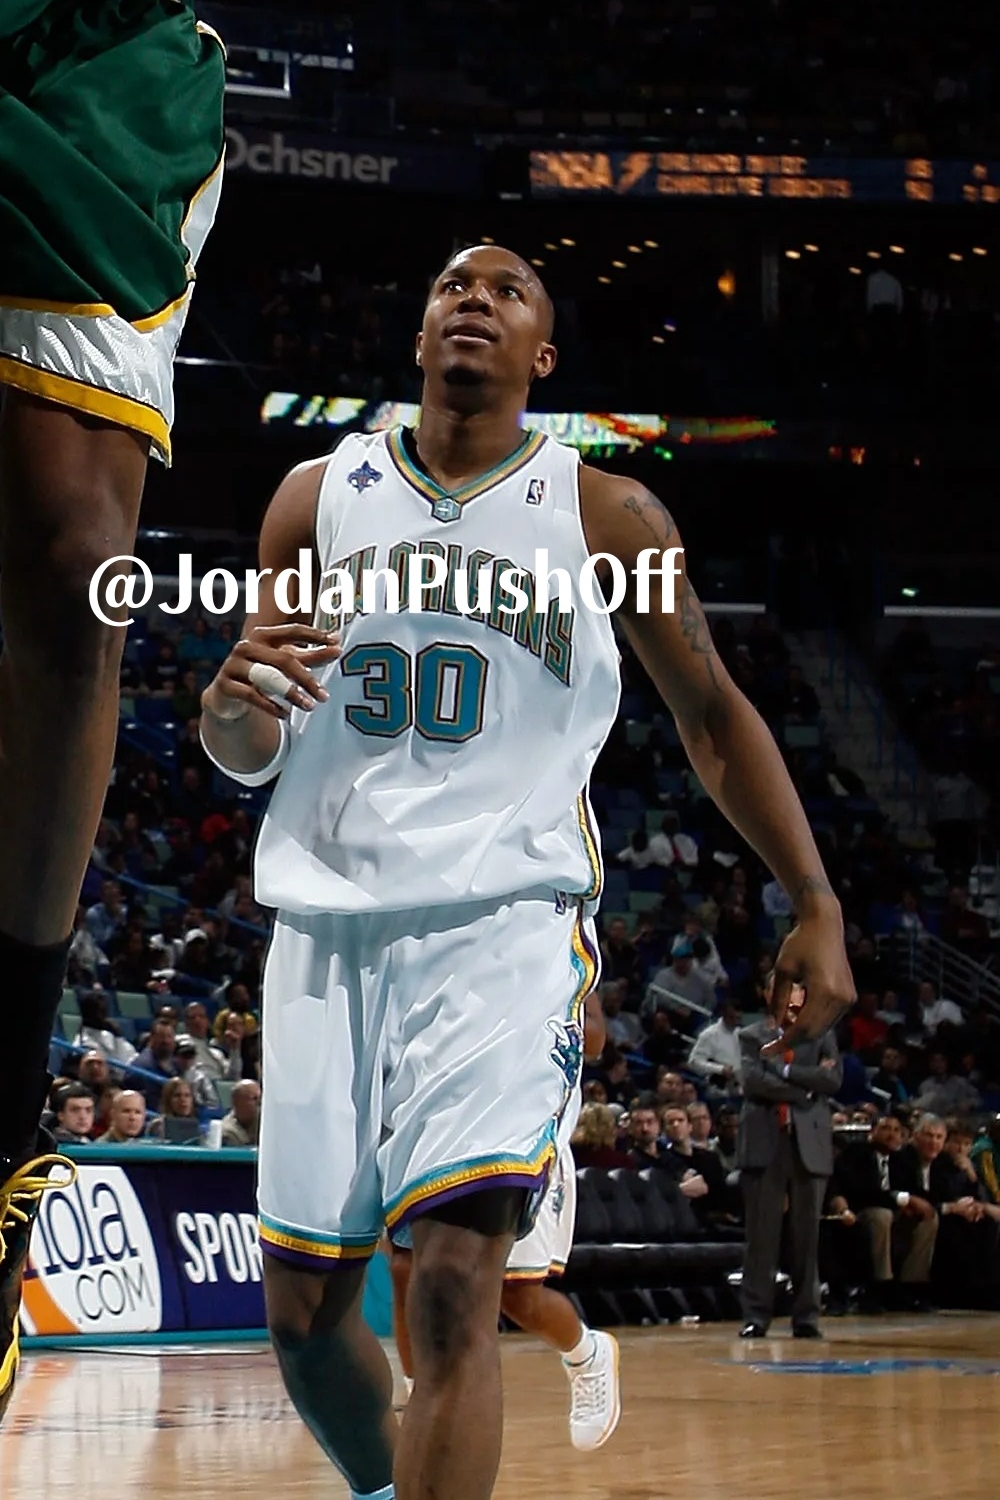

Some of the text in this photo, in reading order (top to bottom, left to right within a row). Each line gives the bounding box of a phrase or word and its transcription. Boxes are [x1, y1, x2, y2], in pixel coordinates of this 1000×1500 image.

[225, 126, 398, 184] Ochsner
[340, 641, 489, 743] 30
[176, 1211, 264, 1284] SPOR
[76, 1262, 155, 1324] .COM
